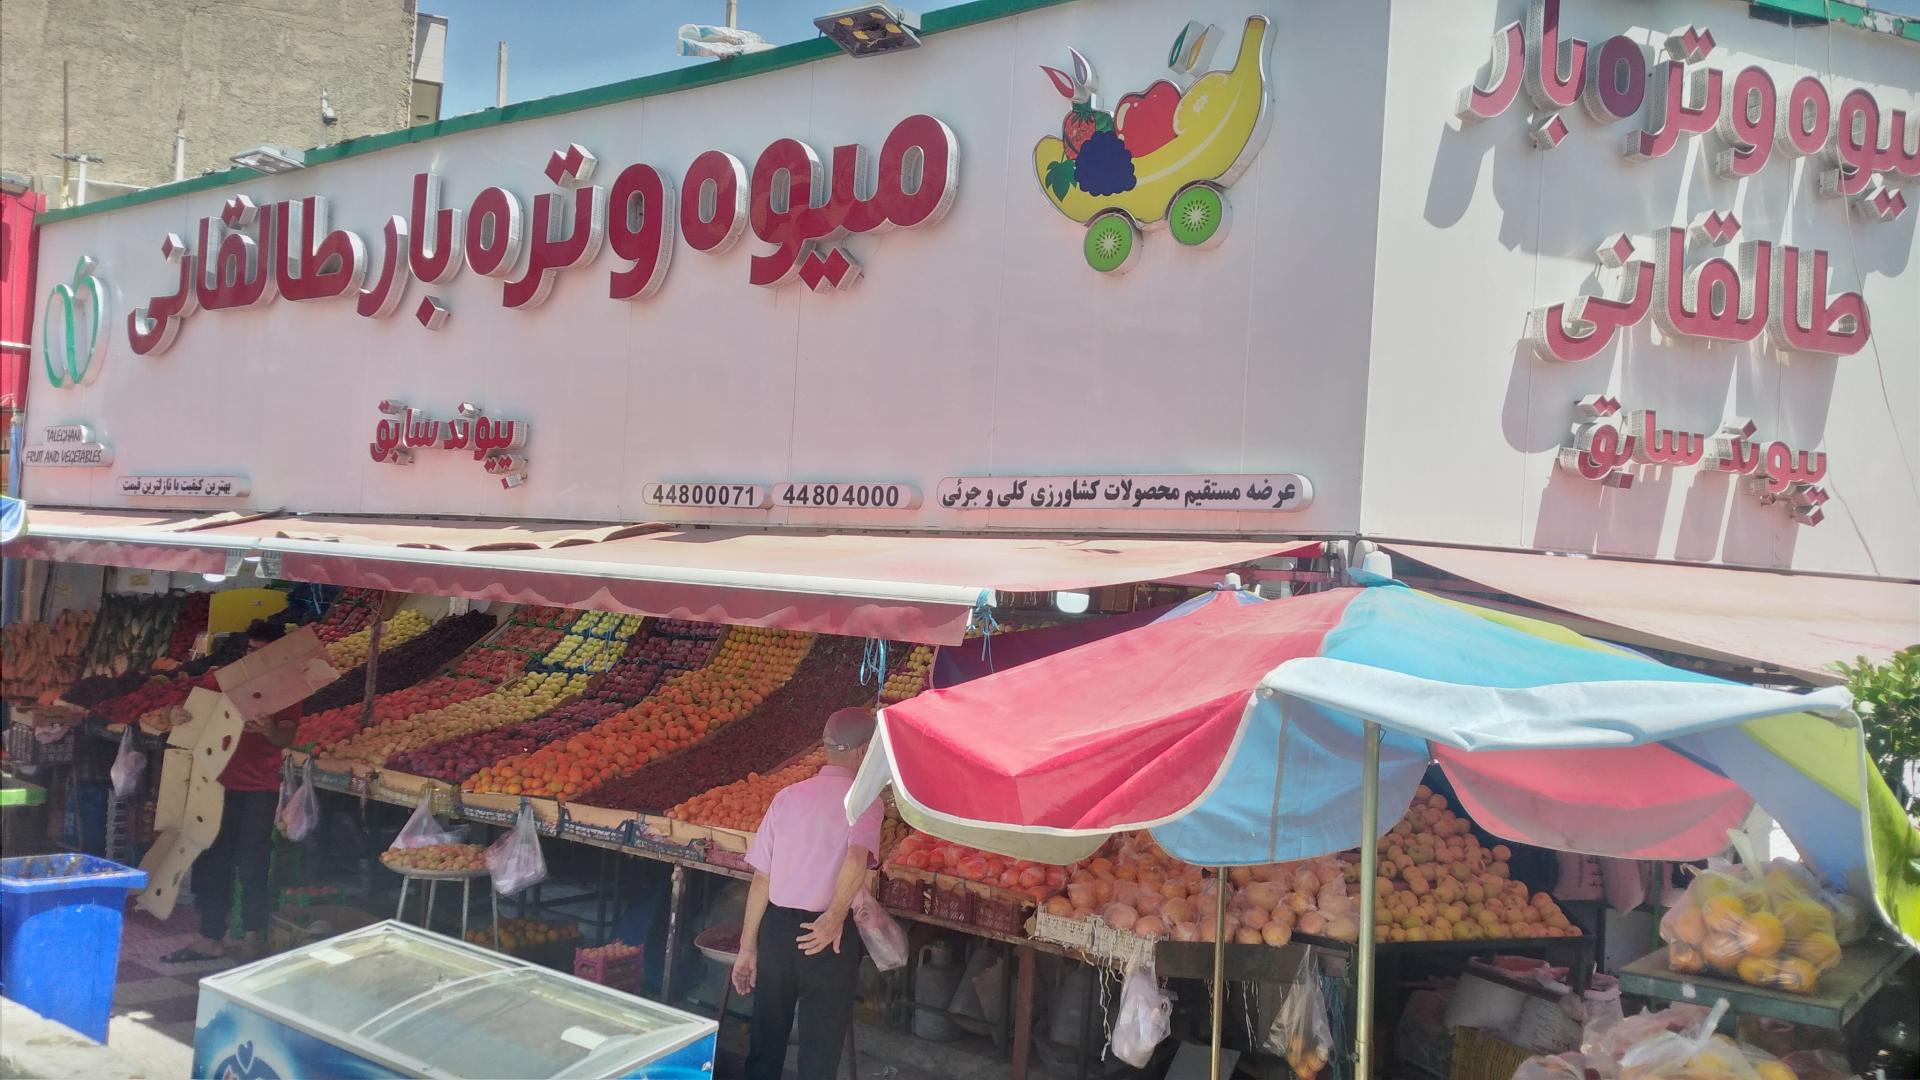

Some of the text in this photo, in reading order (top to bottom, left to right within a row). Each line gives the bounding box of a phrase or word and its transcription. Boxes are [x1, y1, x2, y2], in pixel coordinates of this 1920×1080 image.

[1724, 65, 1777, 177] و
[1788, 76, 1920, 222] یوه
[680, 114, 957, 291] میوه
[608, 163, 672, 300] و
[127, 194, 368, 356] طالقانی
[1538, 210, 1872, 361] طالقانی
[370, 400, 440, 464] سابق
[1565, 395, 1704, 490] سابق
[44, 450, 60, 463] AND
[123, 477, 141, 494] قیمت
[173, 478, 179, 494] با
[181, 478, 204, 495] کیفیت
[205, 480, 231, 496] بهترین
[652, 484, 754, 506] 44800071
[782, 484, 899, 507] 44804000
[985, 488, 993, 507] و
[997, 479, 1028, 507] کلی
[1030, 479, 1101, 507] کشاورزی
[1104, 478, 1180, 507] محصولات
[1184, 479, 1241, 507] مستقیم
[1246, 479, 1296, 508] عرضه
